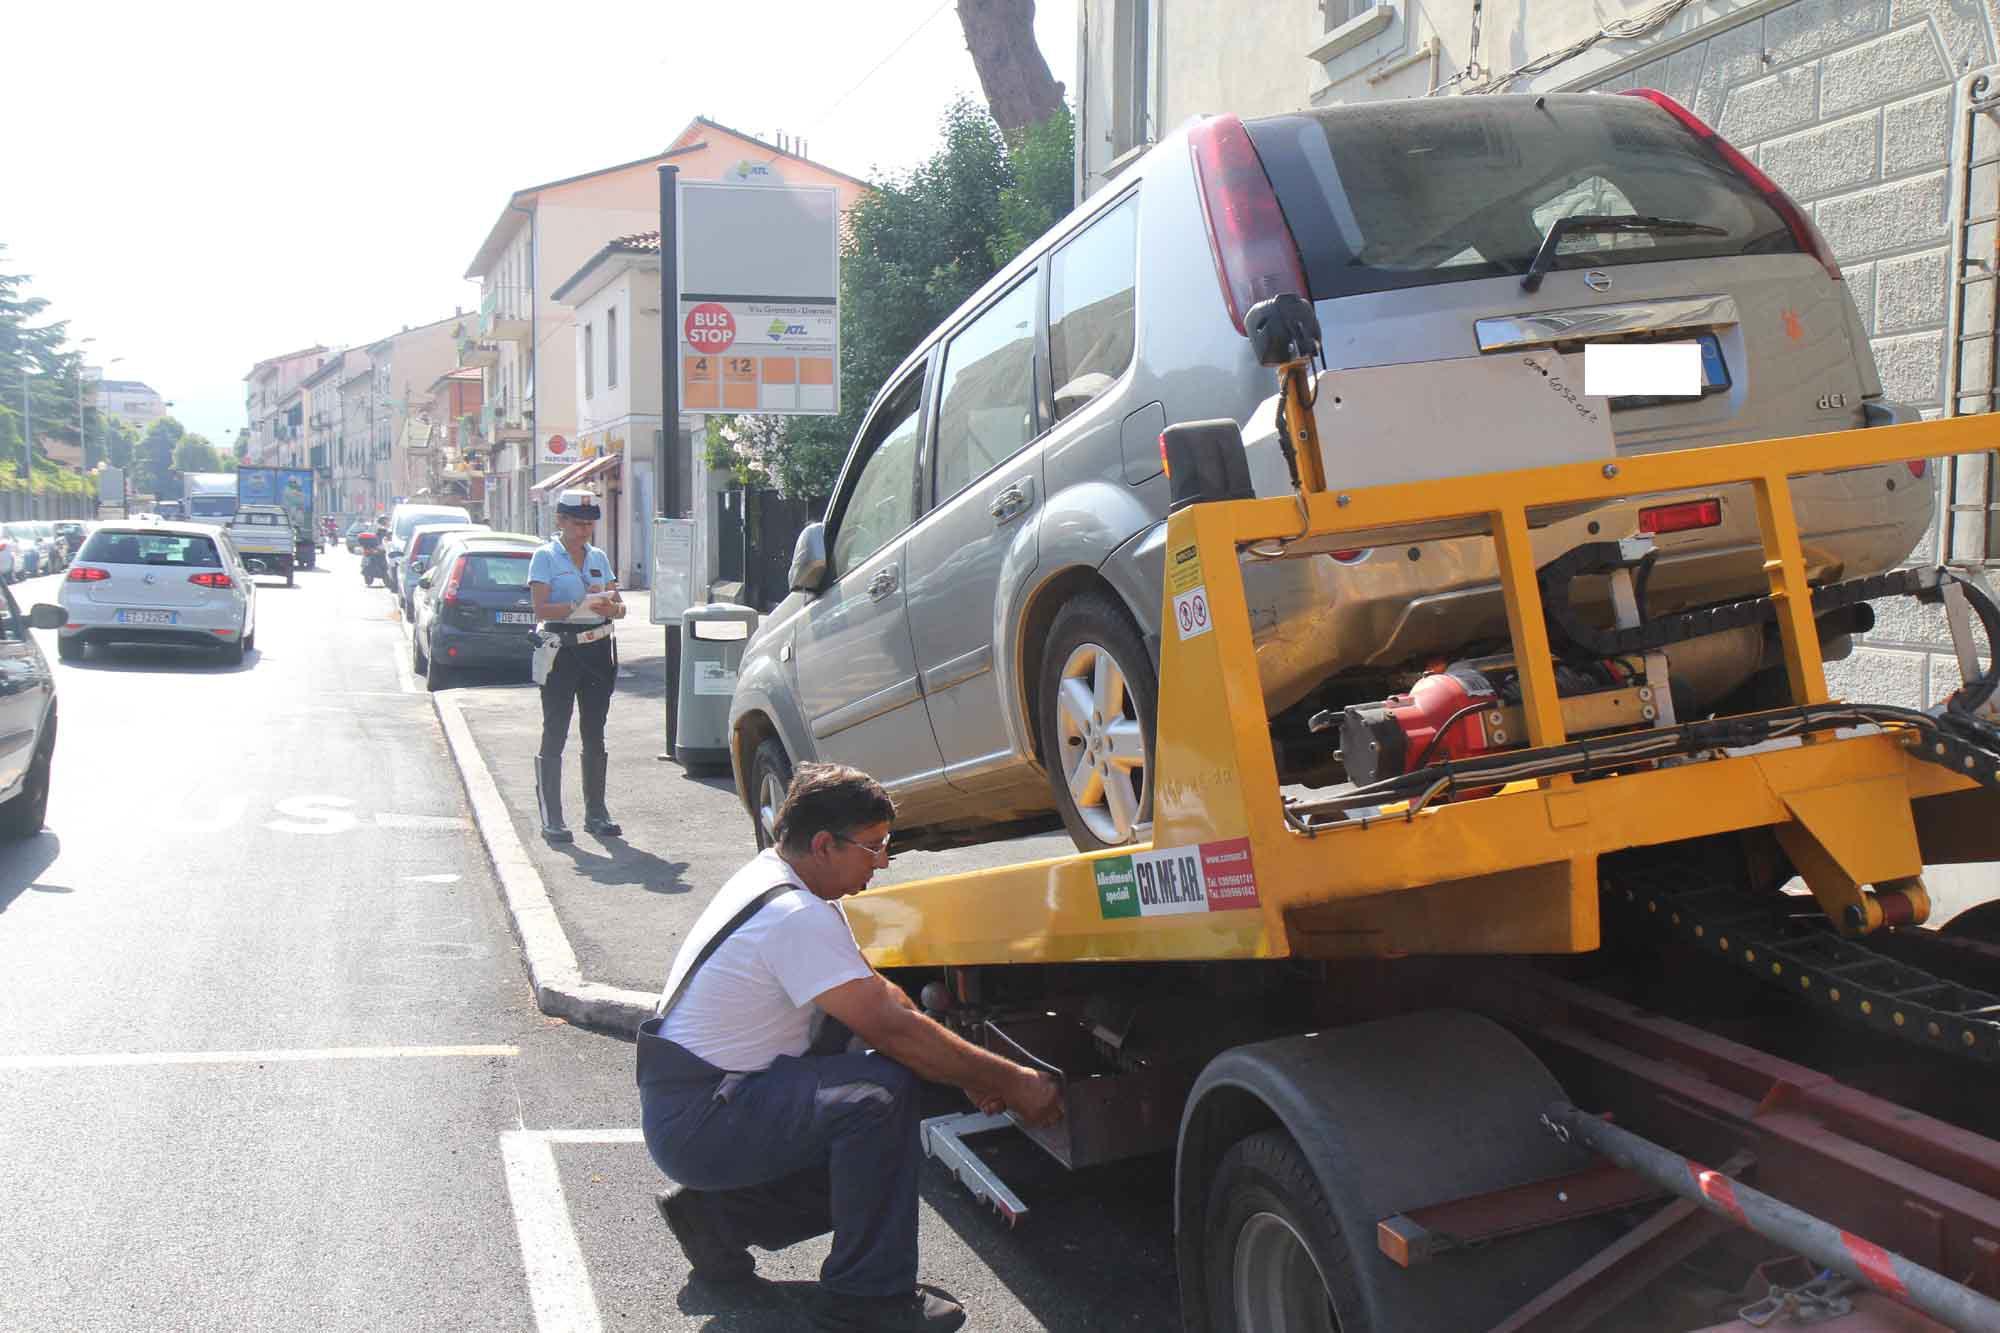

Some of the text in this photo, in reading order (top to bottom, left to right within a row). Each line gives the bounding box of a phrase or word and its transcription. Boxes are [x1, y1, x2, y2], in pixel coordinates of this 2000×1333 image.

[694, 312, 728, 327] BUS
[689, 328, 734, 344] STOP
[784, 325, 808, 335] ATL
[695, 357, 753, 373] 4 12
[1817, 393, 1848, 409] dCi
